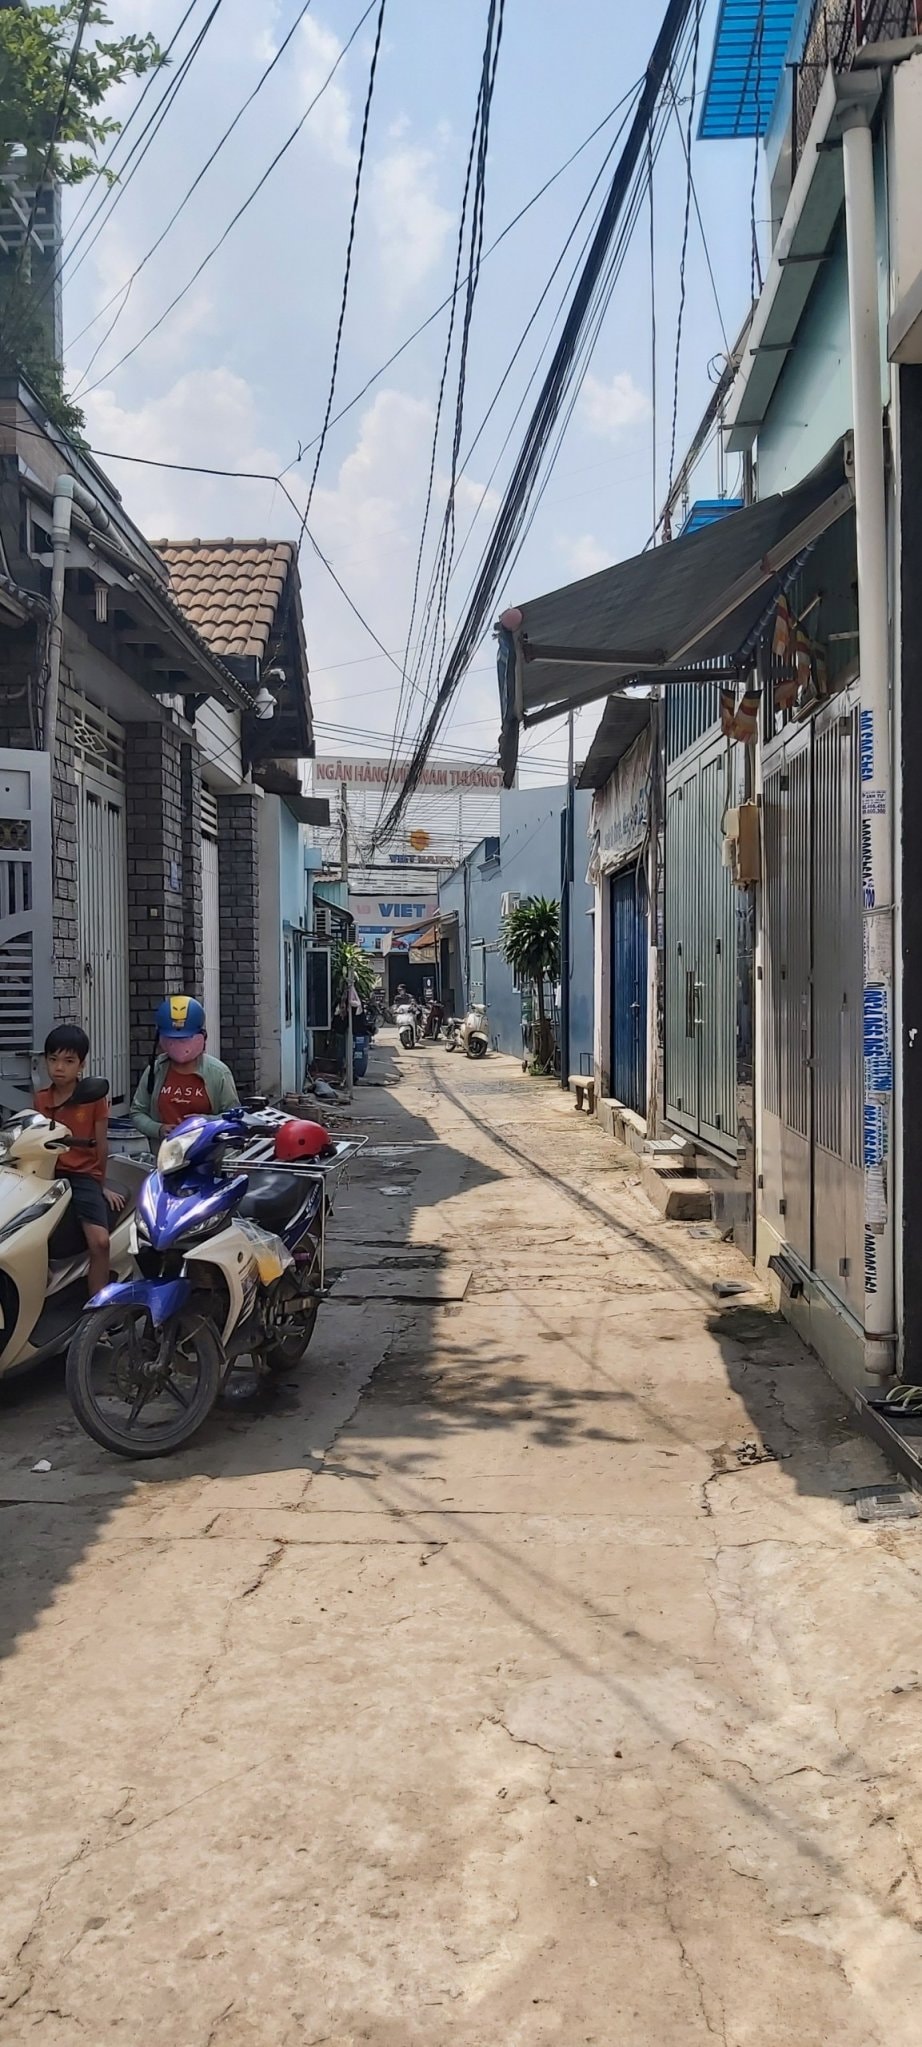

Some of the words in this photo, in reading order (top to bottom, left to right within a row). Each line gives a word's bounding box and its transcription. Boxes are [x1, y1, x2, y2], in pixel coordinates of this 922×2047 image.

[316, 760, 353, 782] NGÂN
[354, 761, 389, 783] HÀNG
[420, 768, 448, 786] NAM
[378, 902, 426, 918] VIET
[161, 1086, 203, 1097] MASK
